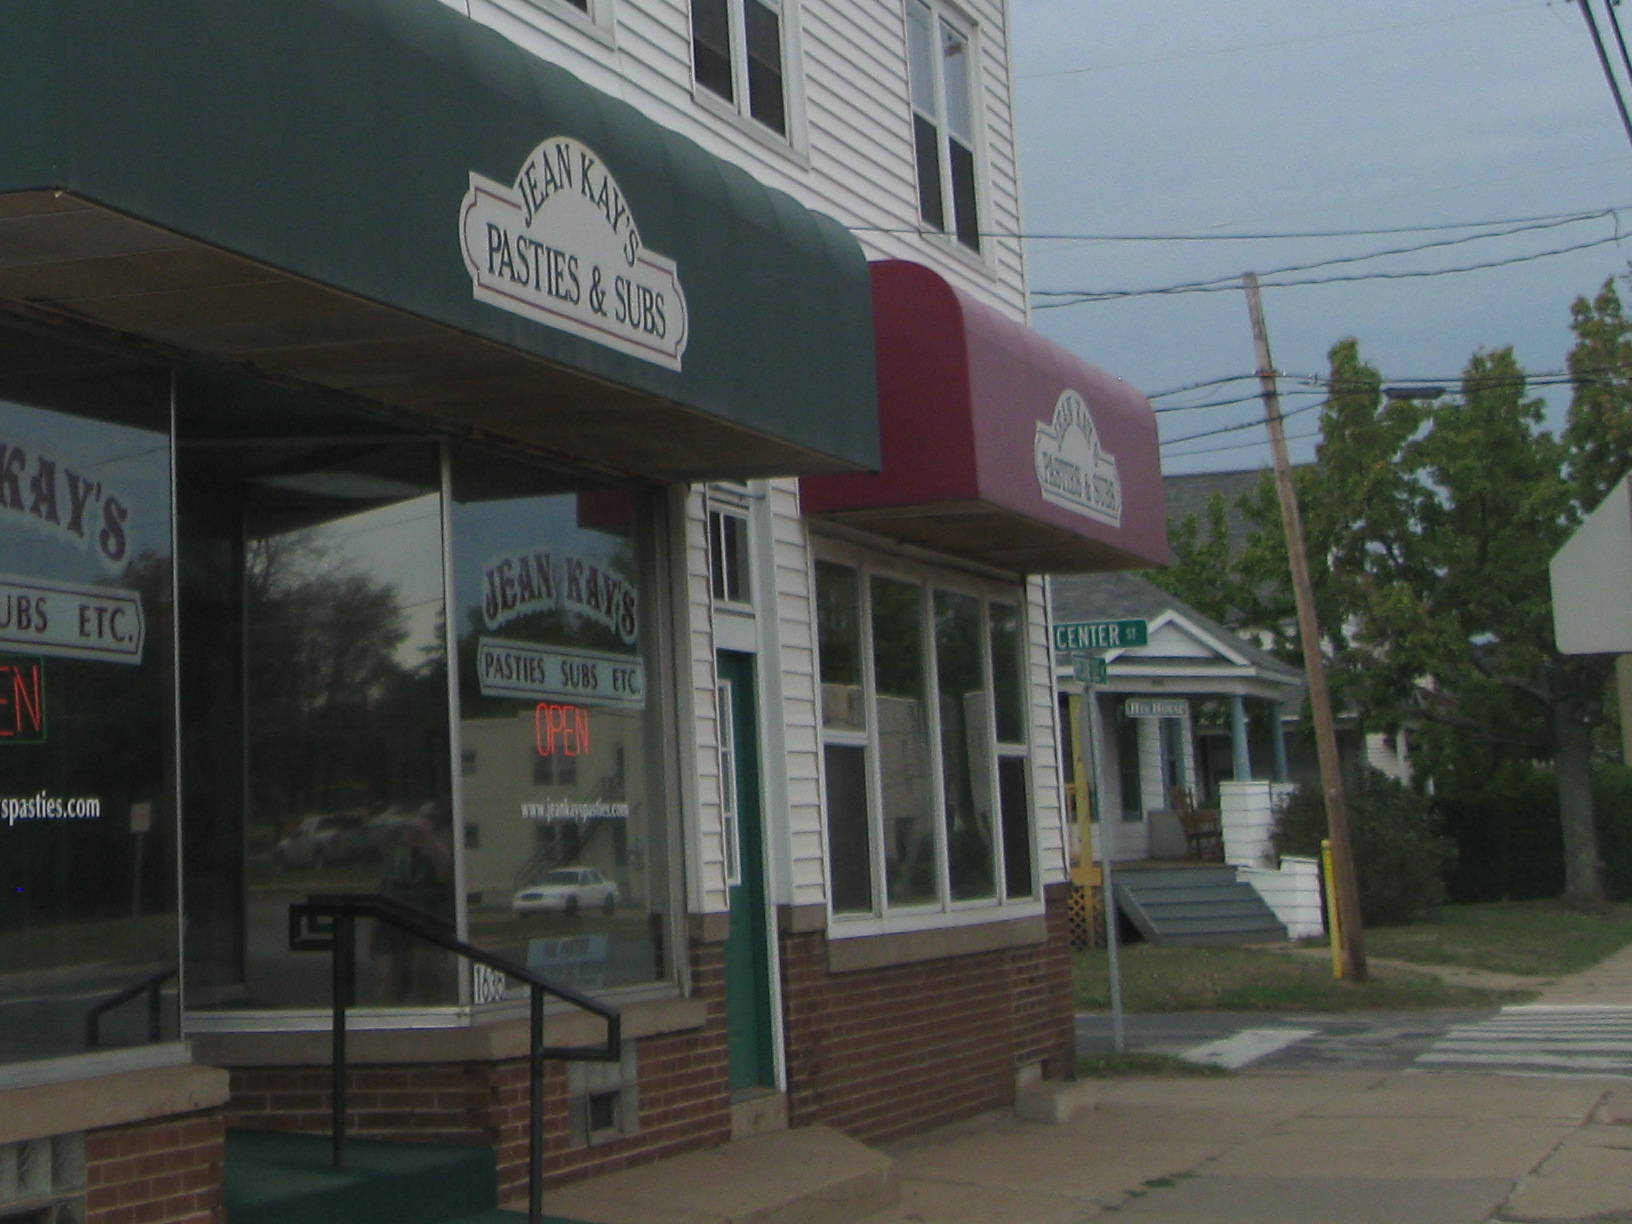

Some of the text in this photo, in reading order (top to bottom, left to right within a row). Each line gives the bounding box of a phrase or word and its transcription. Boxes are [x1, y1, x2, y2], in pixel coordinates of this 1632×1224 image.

[518, 143, 639, 267] JEAN KAY'S
[486, 222, 666, 340] PASTIES & SUBS
[78, 604, 134, 643] ETC.
[484, 552, 637, 640] JEAN KAY'S
[1056, 624, 1121, 649] CENTER
[485, 652, 546, 684] PASTIES
[560, 660, 599, 691] SUBS
[534, 702, 591, 757] OPEN
